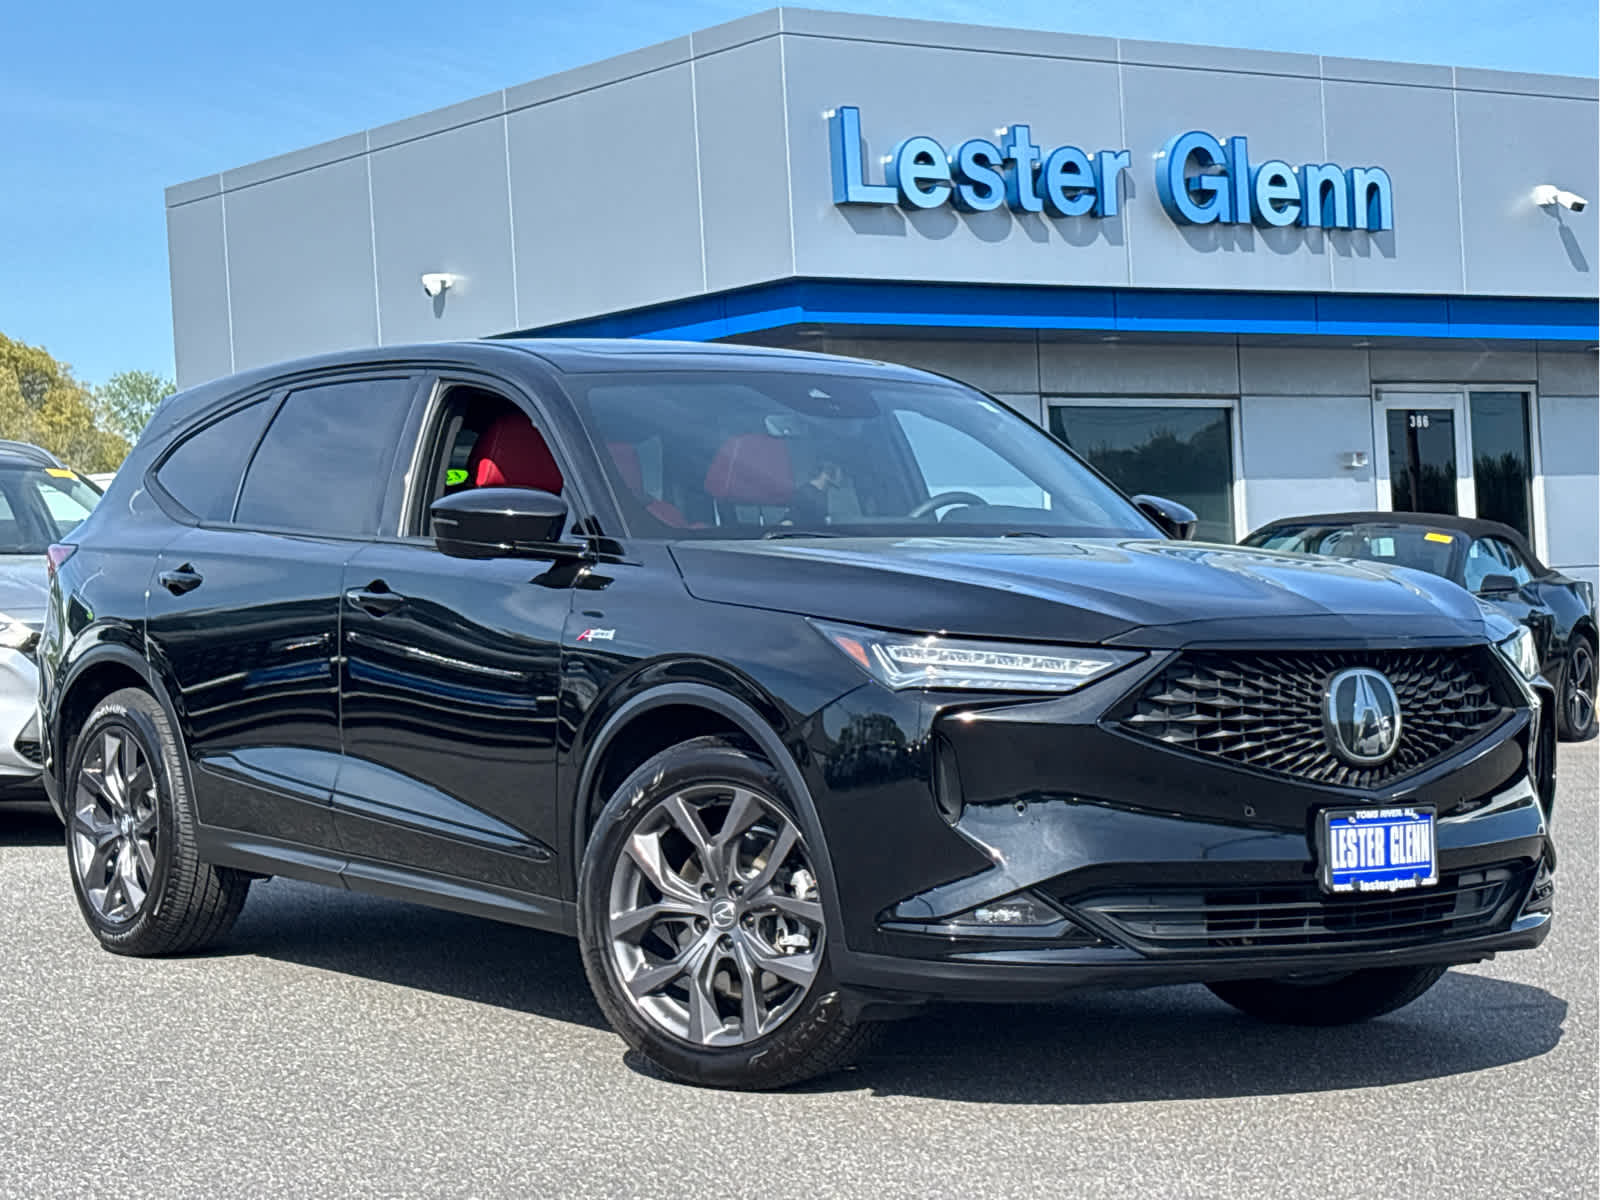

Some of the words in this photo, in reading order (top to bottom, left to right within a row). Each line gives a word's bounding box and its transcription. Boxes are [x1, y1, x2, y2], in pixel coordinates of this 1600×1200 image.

[829, 106, 1131, 218] Lester
[1155, 130, 1394, 232] Glenn
[1330, 826, 1386, 869] LESTER
[1389, 823, 1431, 866] GLENN
